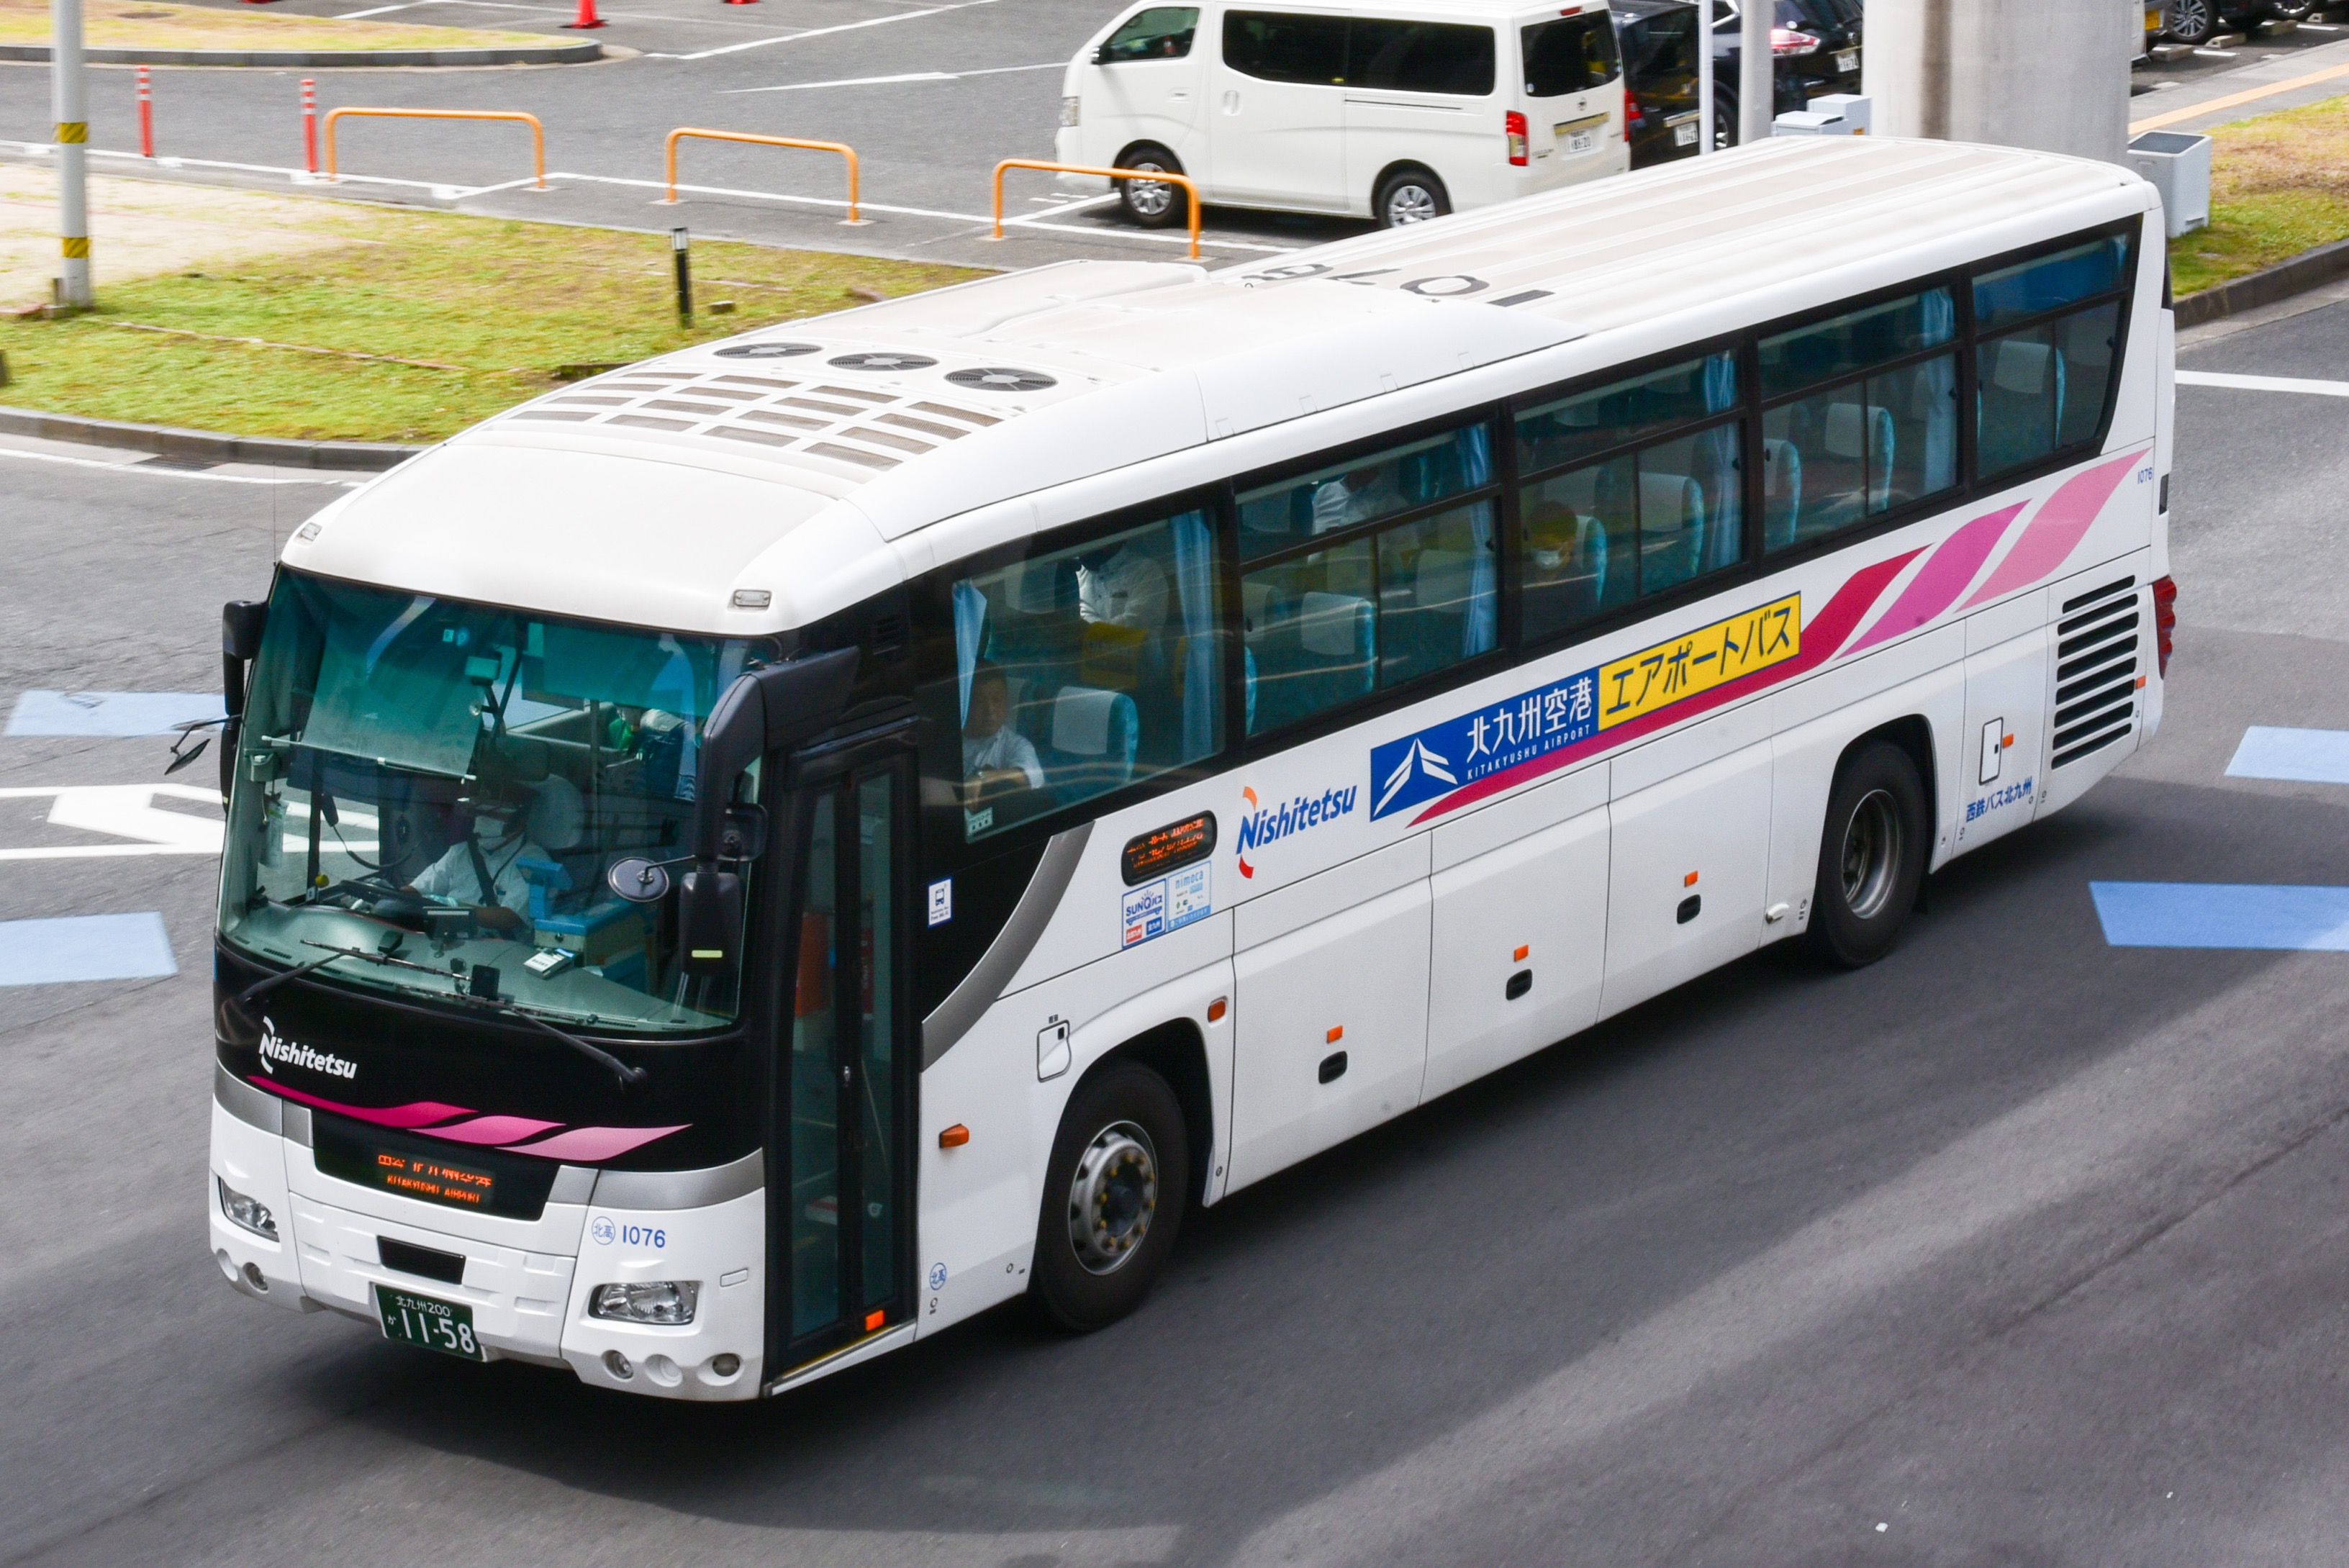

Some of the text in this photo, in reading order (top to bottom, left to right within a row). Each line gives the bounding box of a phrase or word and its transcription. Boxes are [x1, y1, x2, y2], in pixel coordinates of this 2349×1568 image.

[2137, 467, 2153, 484] 1076
[1606, 606, 1792, 716] エアポートバス
[1466, 676, 1593, 763] 北九州空港
[1467, 724, 1590, 780] KITAKYUSHU AIRPORT
[1235, 784, 1358, 856] Nishitetsu
[1965, 775, 2033, 823] 西鉄バス北九州
[1175, 870, 1204, 890] nimoca
[258, 1032, 358, 1079] Nishitetsu
[623, 1225, 666, 1248] 1076
[401, 1308, 476, 1354] 11-58
